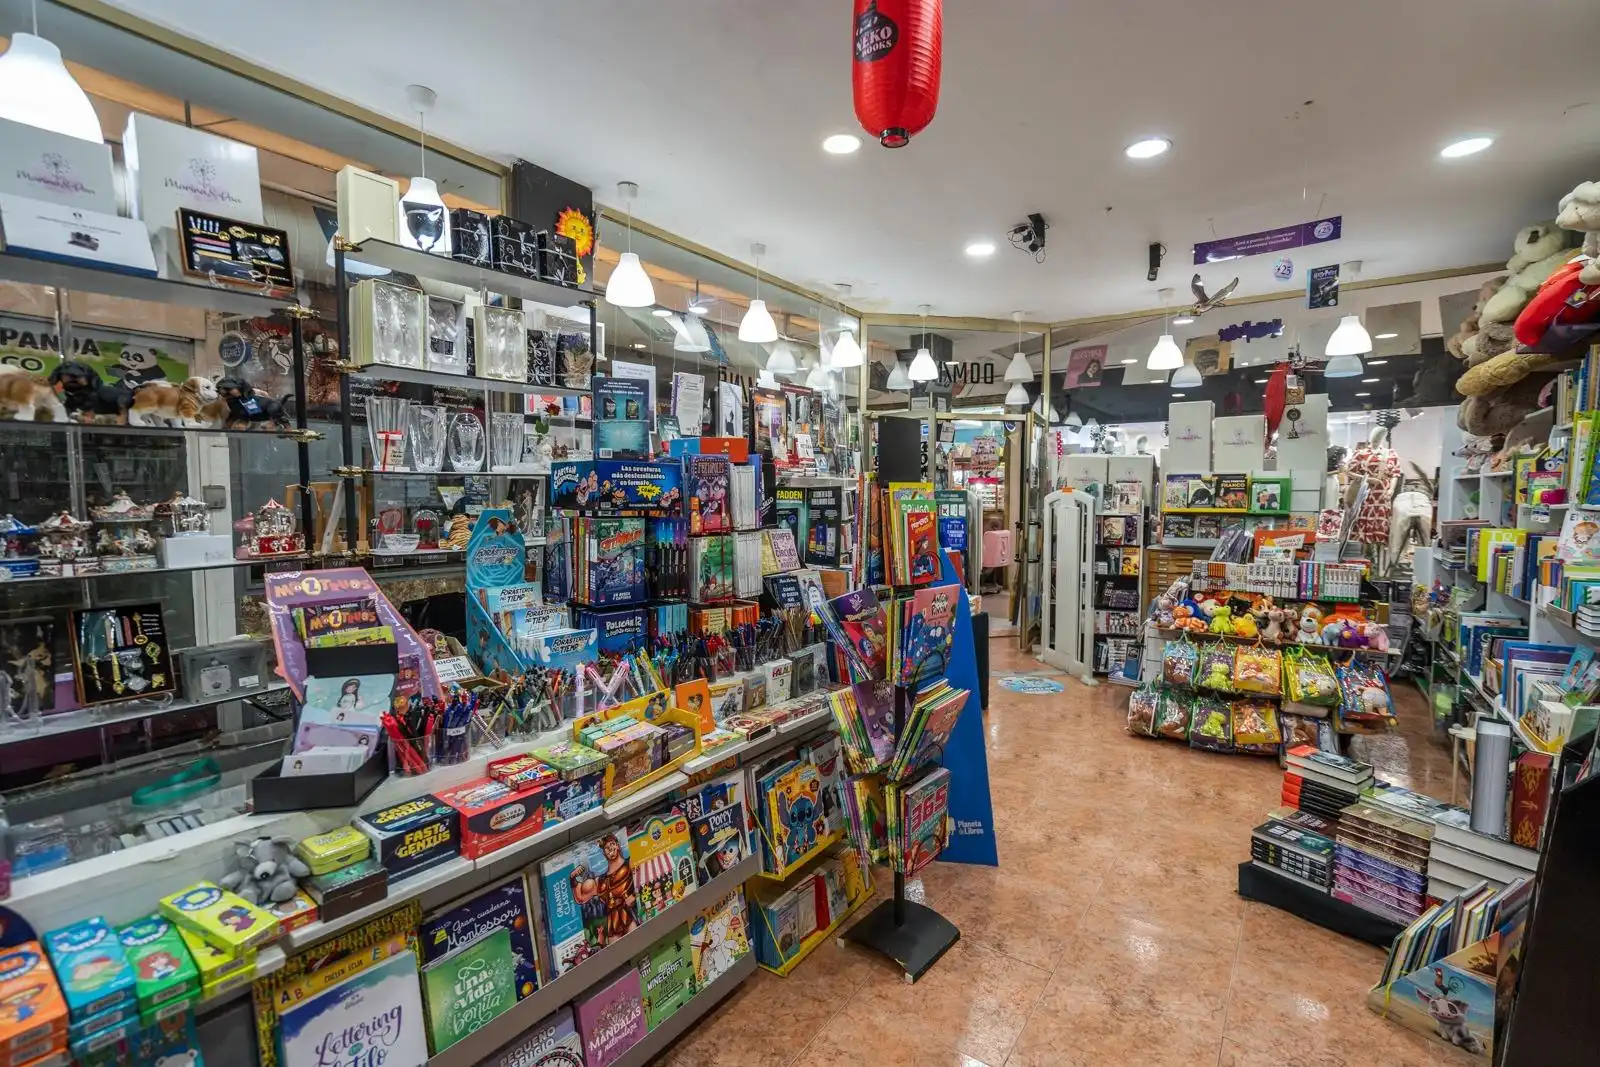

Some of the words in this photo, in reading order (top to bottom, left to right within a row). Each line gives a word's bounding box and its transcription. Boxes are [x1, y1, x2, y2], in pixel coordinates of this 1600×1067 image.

[776, 490, 803, 499] FADDEN
[911, 782, 948, 833] 365
[404, 821, 441, 846] FAST
[957, 819, 982, 828] Planeta
[964, 827, 984, 835] Libros
[398, 829, 451, 858] GENIUS
[553, 882, 564, 918] GRANDES
[446, 904, 521, 954] Montessori
[452, 919, 476, 934] Gran
[647, 957, 684, 992] MINECRAFT
[281, 990, 291, 1004] A
[315, 1004, 403, 1066] Lettering
[507, 1037, 556, 1067] EFUGIO
